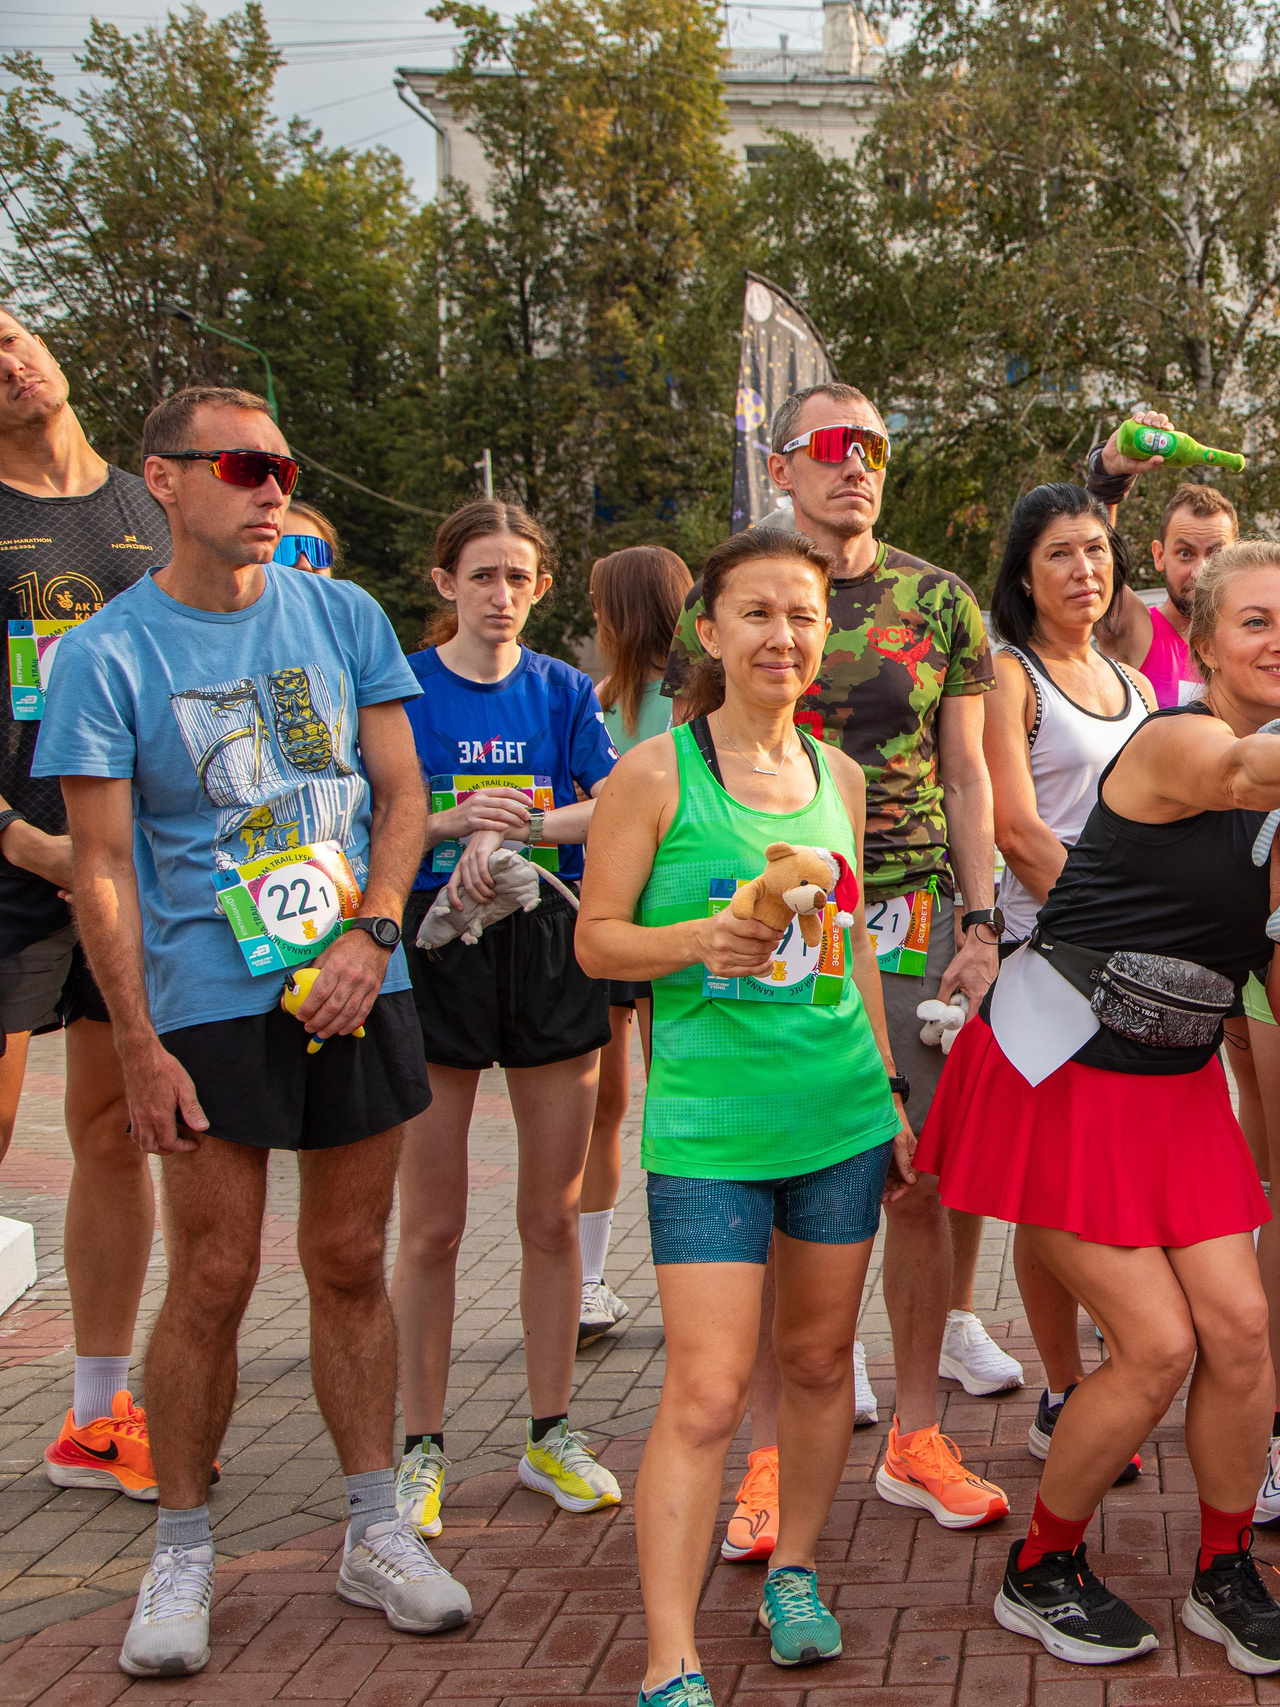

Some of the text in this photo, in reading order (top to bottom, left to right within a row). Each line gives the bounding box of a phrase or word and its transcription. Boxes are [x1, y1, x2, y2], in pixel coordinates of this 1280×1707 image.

[111, 543, 153, 551] NORDSKI
[75, 602, 91, 611] АК
[38, 628, 62, 648] DREAM
[867, 626, 916, 645] OCR
[458, 784, 480, 804] DREAM
[481, 779, 502, 788] TRAIL
[251, 867, 271, 892] DREAM
[271, 854, 294, 868] TRAIL
[250, 905, 262, 926] TRAIL
[918, 900, 928, 943] ЭСТАФЕТА
[282, 943, 311, 955] KANNAS
[322, 935, 335, 949] ЛЕС
[880, 956, 891, 965] ЛЕС
[741, 976, 775, 997] KANNAS
[789, 986, 804, 996] ЛЕС
[1123, 998, 1160, 1019] WILD TRAIL
